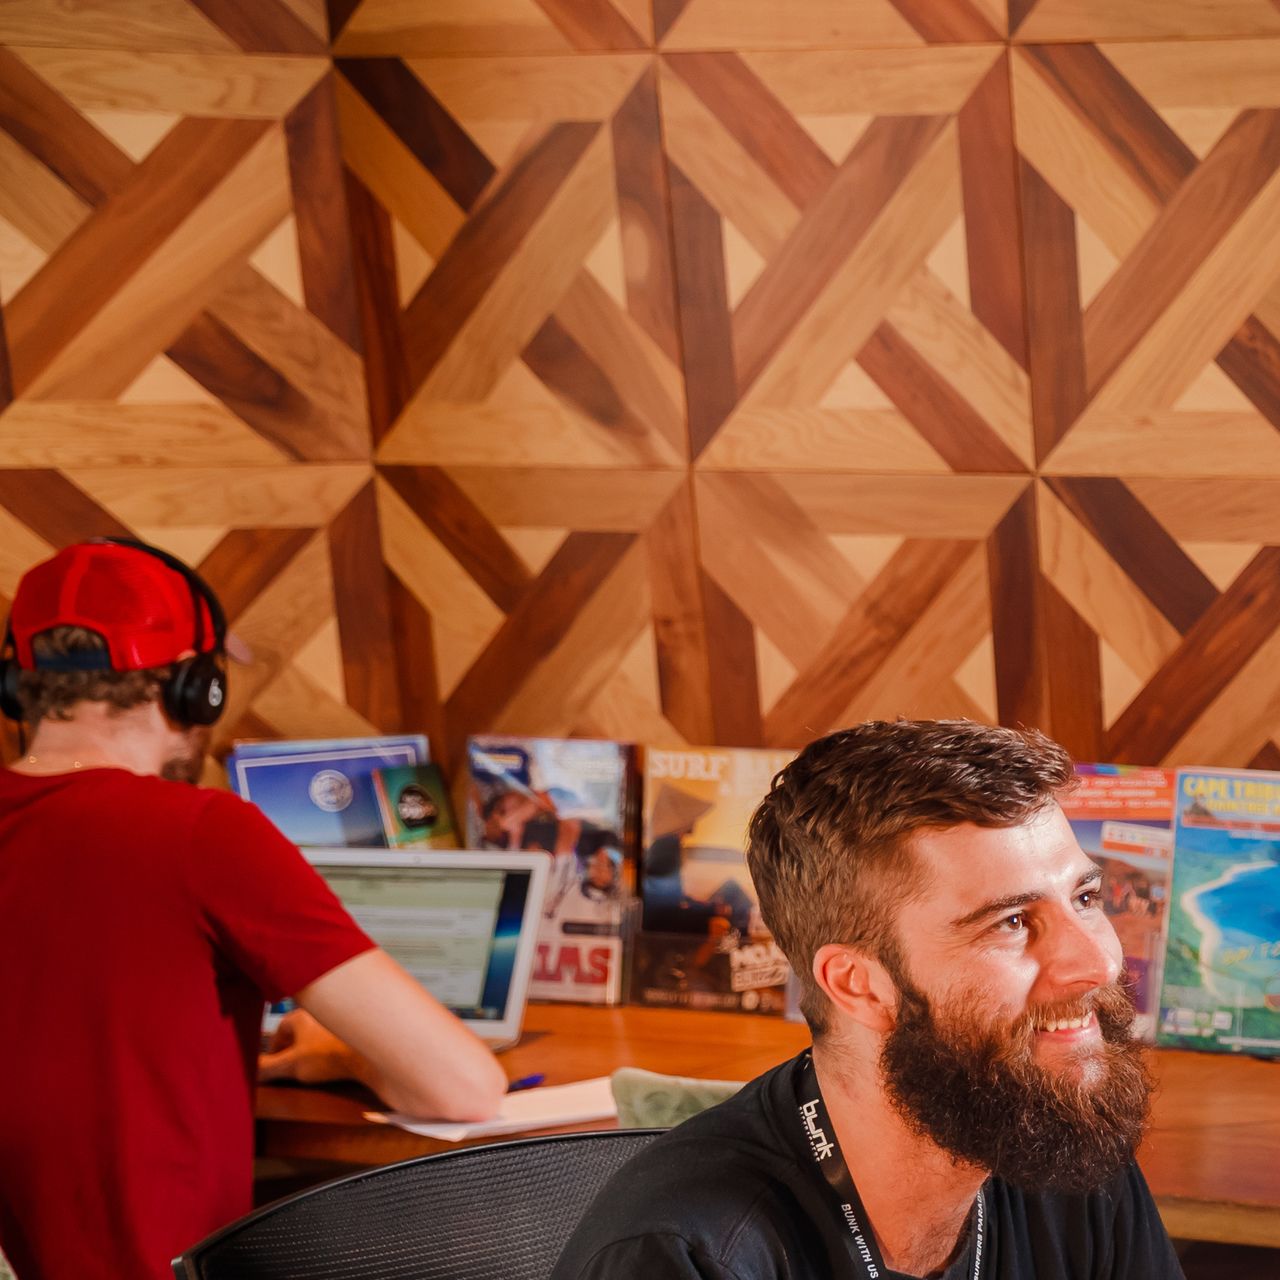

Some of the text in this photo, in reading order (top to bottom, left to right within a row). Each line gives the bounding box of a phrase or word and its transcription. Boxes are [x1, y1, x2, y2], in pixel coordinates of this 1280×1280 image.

[650, 749, 729, 781] SURF
[802, 1099, 834, 1160] bunk
[841, 1202, 860, 1235] BUNK
[855, 1233, 873, 1265] WITH
[867, 1263, 878, 1280] US
